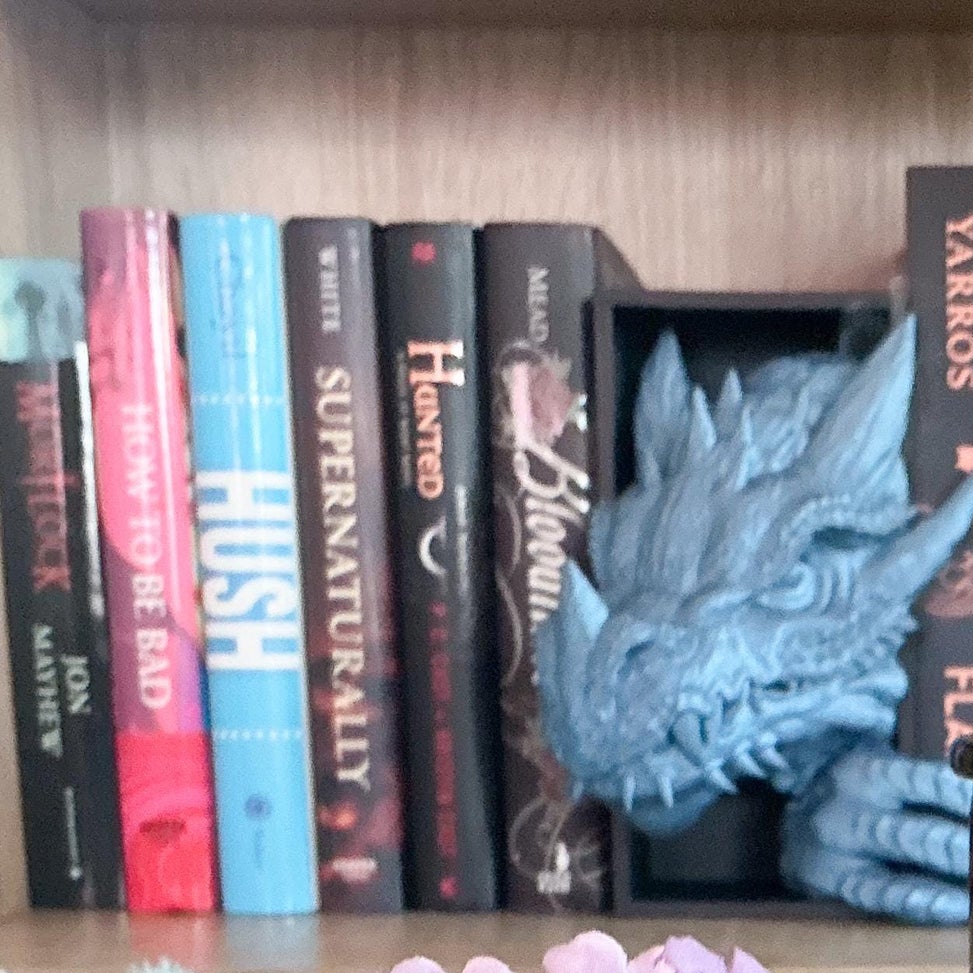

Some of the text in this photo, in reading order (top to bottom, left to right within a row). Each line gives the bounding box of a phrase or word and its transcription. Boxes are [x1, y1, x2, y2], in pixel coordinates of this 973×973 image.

[318, 245, 341, 332] WHITE
[527, 265, 550, 342] MEAD
[121, 403, 172, 710] HOW TO BE BAD
[196, 470, 300, 671] HUSH
[314, 365, 371, 791] SUPERNATURALLY
[32, 622, 63, 758] MAYHEW
[60, 655, 91, 714] JON
